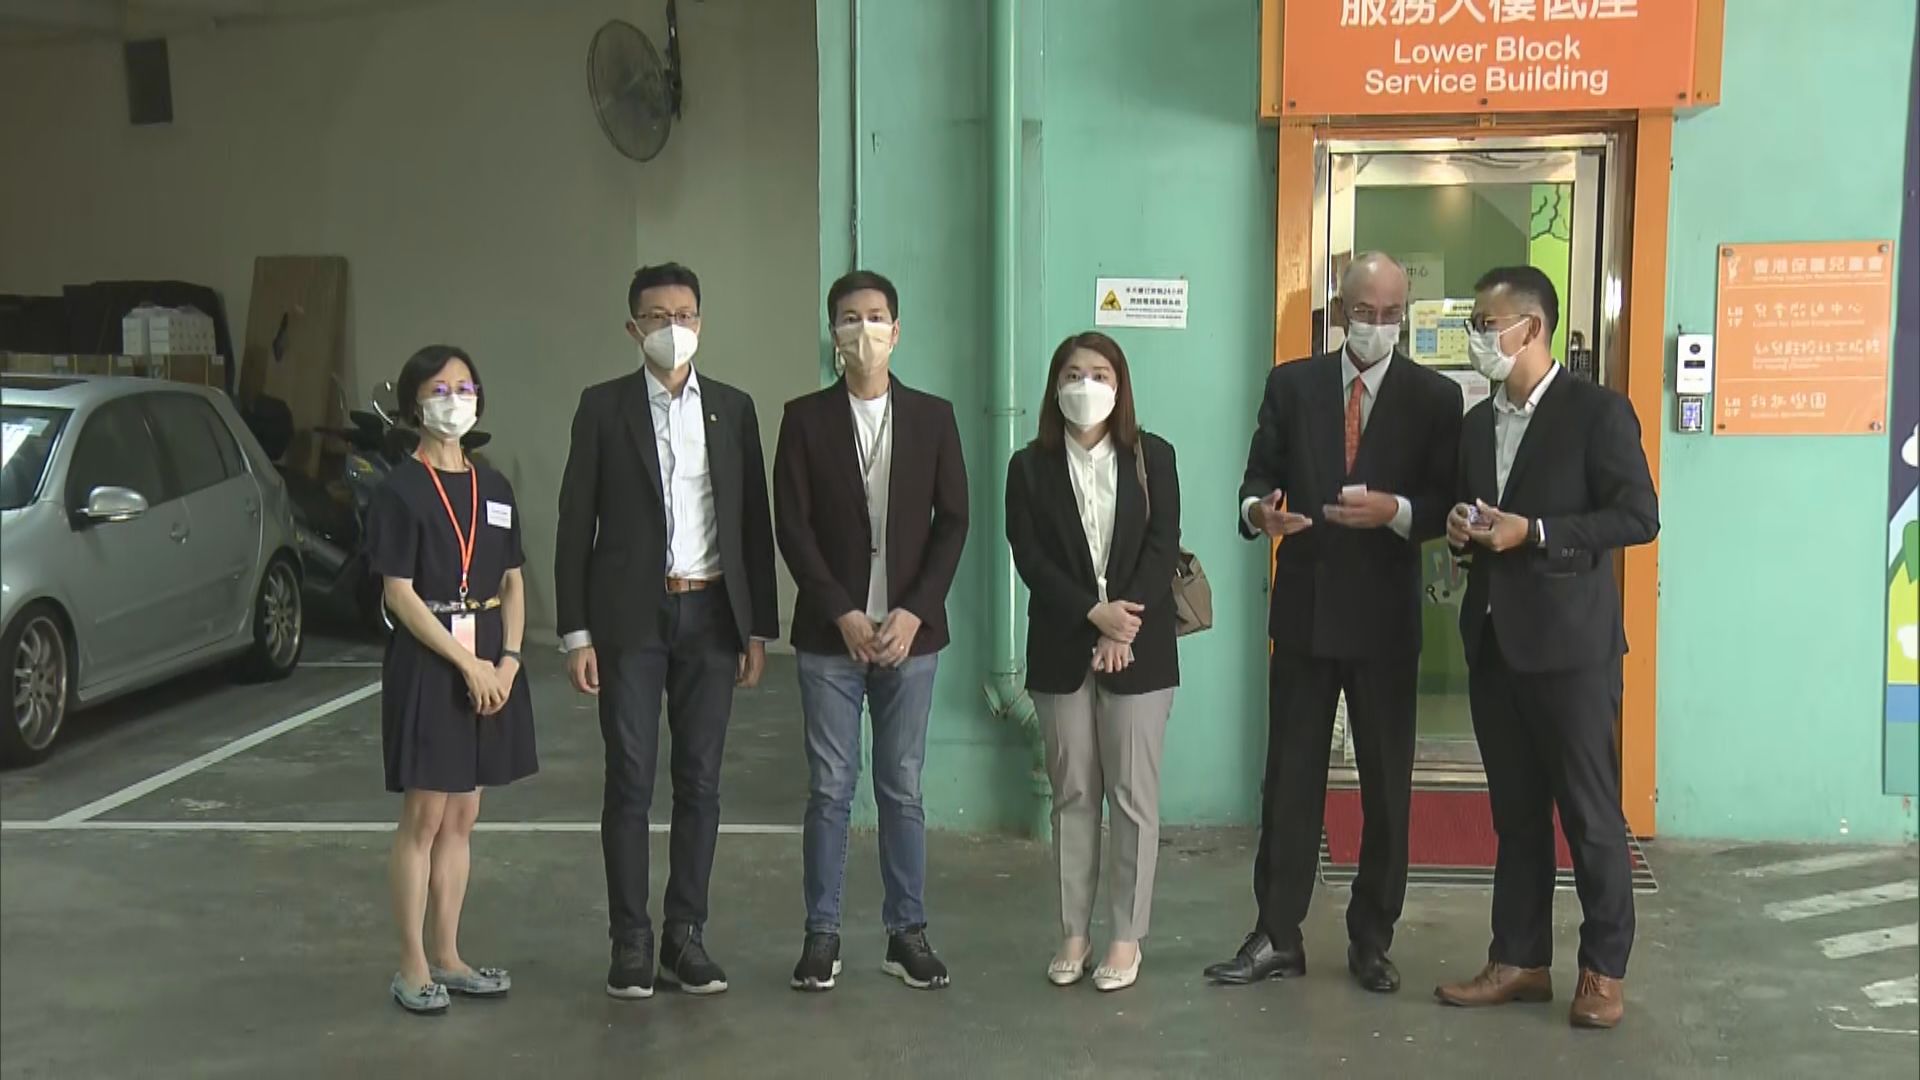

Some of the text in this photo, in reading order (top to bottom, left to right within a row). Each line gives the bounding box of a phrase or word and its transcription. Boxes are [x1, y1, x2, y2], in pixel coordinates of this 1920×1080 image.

[1394, 34, 1582, 64] Lower Block
[1365, 64, 1609, 96] Service Building
